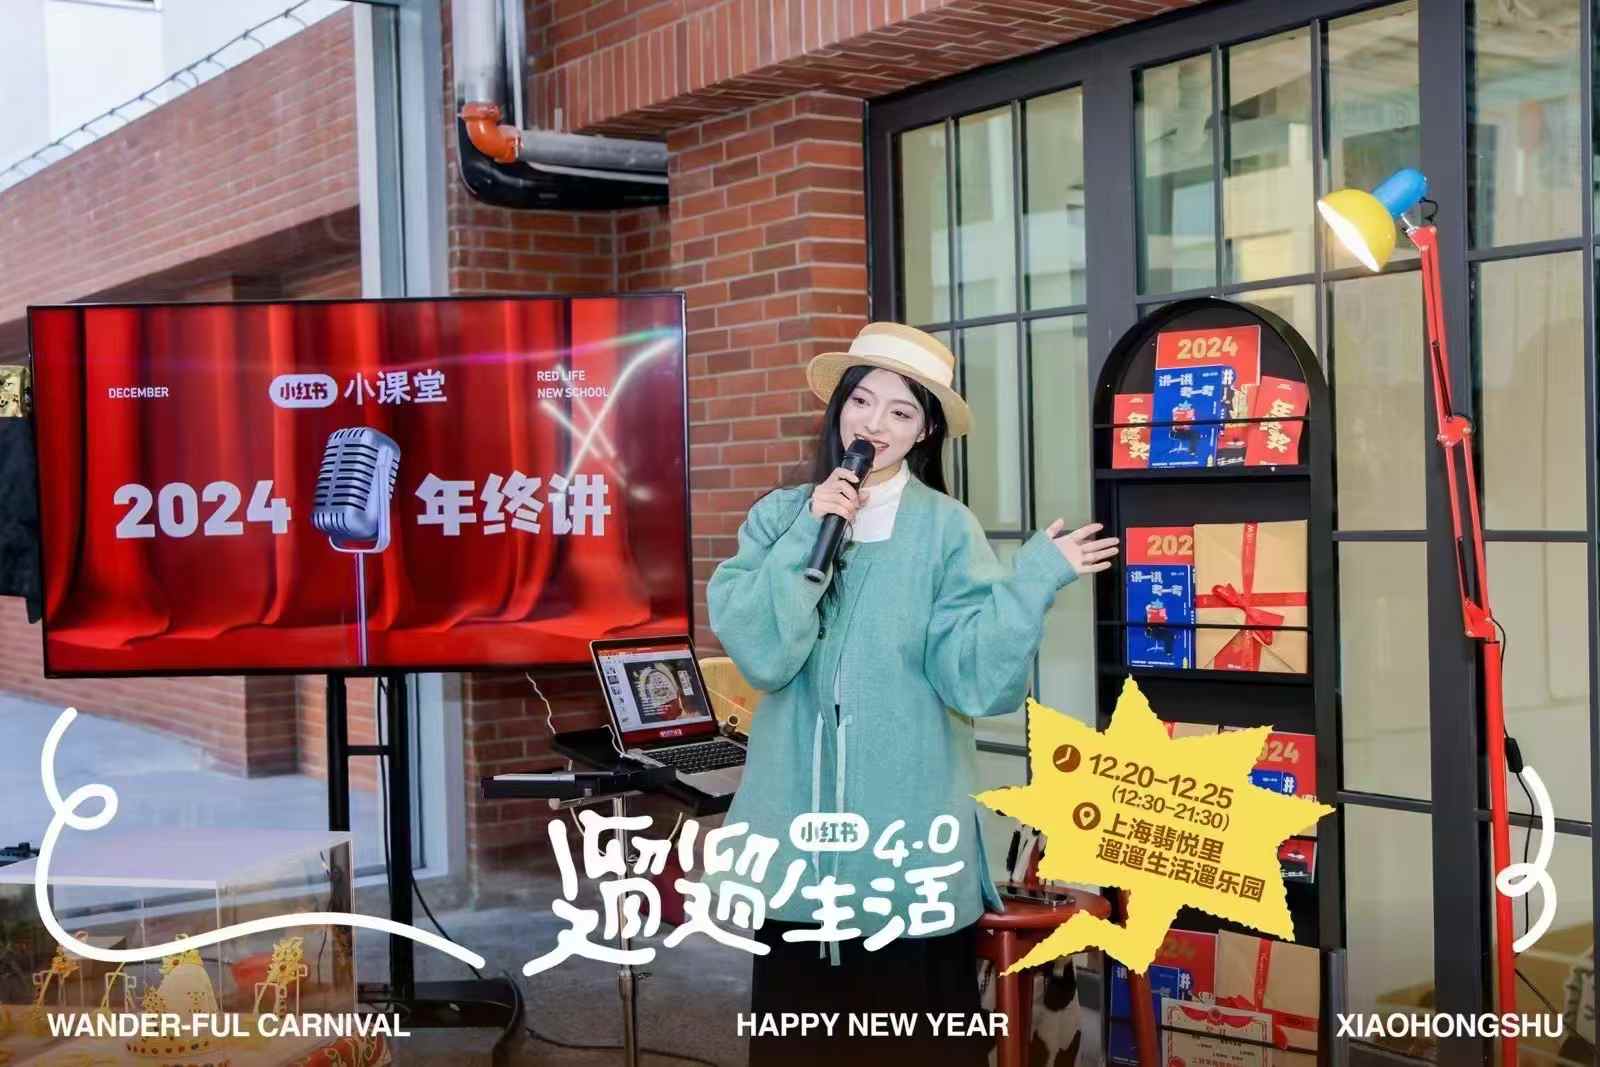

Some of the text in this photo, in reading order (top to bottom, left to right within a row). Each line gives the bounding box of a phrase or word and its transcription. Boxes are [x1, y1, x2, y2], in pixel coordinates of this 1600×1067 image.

[1176, 336, 1238, 360] 2024
[280, 369, 448, 406] 小红书 小课堂
[537, 370, 586, 382] RED LIFE
[108, 386, 169, 399] DECEMBER
[537, 386, 608, 399] NEW SCHOOL
[113, 480, 292, 538] 2024
[415, 470, 611, 536] 年终讲
